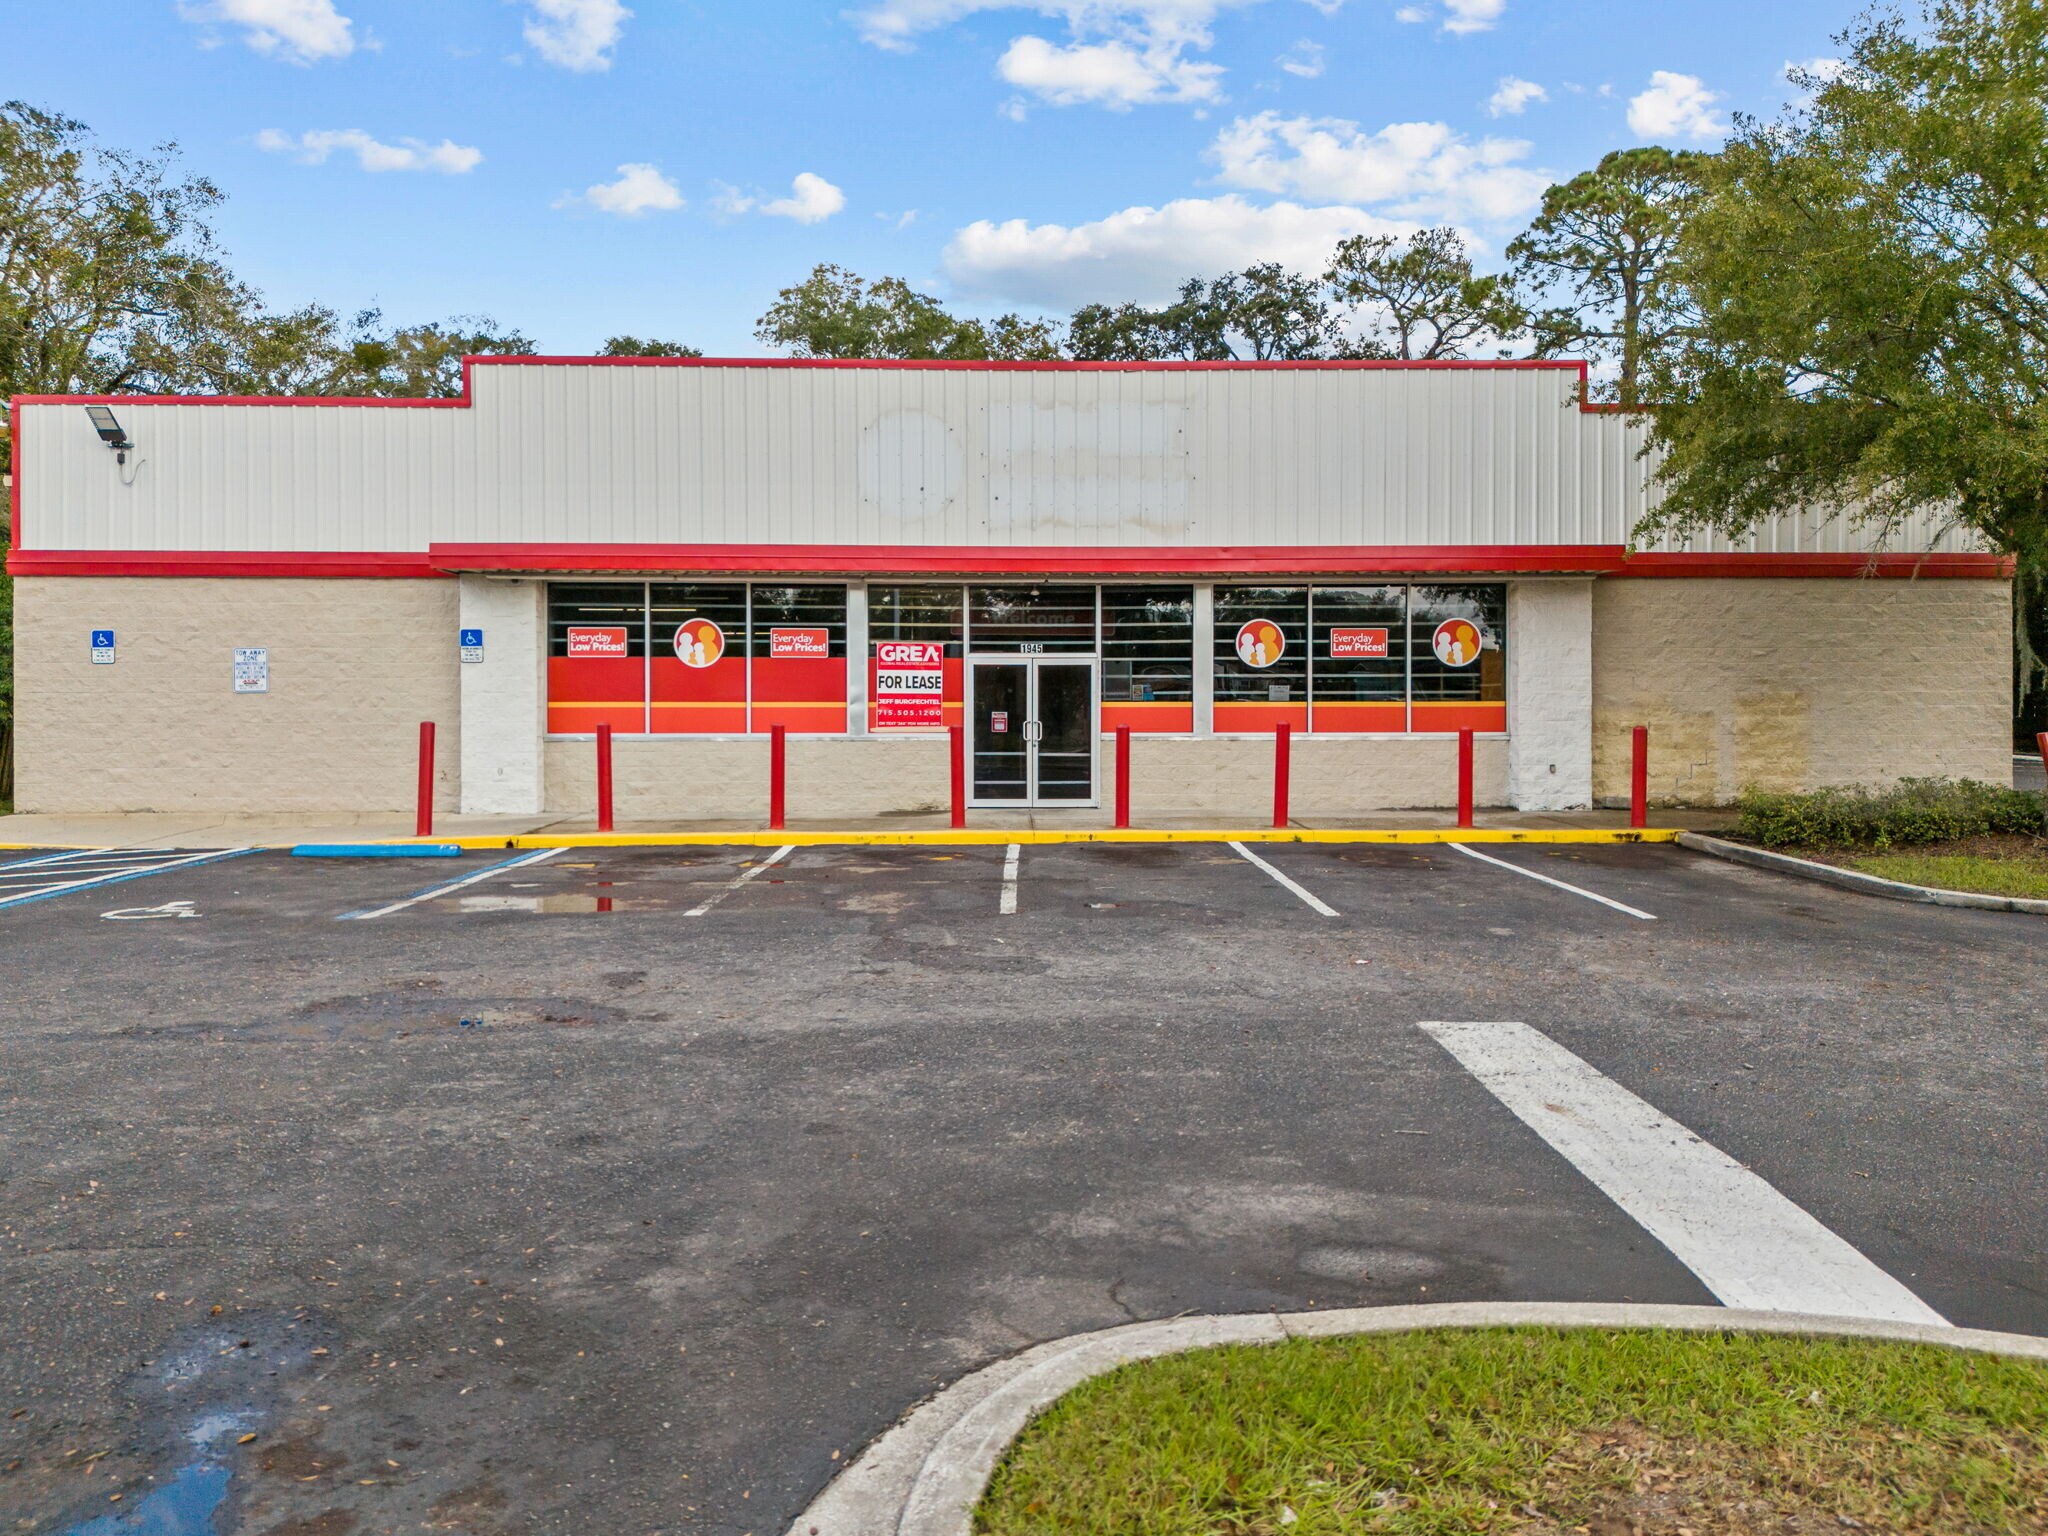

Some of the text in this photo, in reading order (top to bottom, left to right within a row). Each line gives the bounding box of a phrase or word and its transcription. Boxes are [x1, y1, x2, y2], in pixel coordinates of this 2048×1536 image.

[570, 632, 612, 645] Everyday
[773, 633, 814, 646] Everyday
[1333, 633, 1374, 646] Everyday
[570, 642, 625, 652] Low Prices!
[773, 643, 826, 652] Low Prices!
[880, 645, 940, 662] GREA
[1022, 644, 1042, 653] 1945
[1333, 643, 1386, 652] Low Prices!
[878, 675, 941, 690] FOR LEASE
